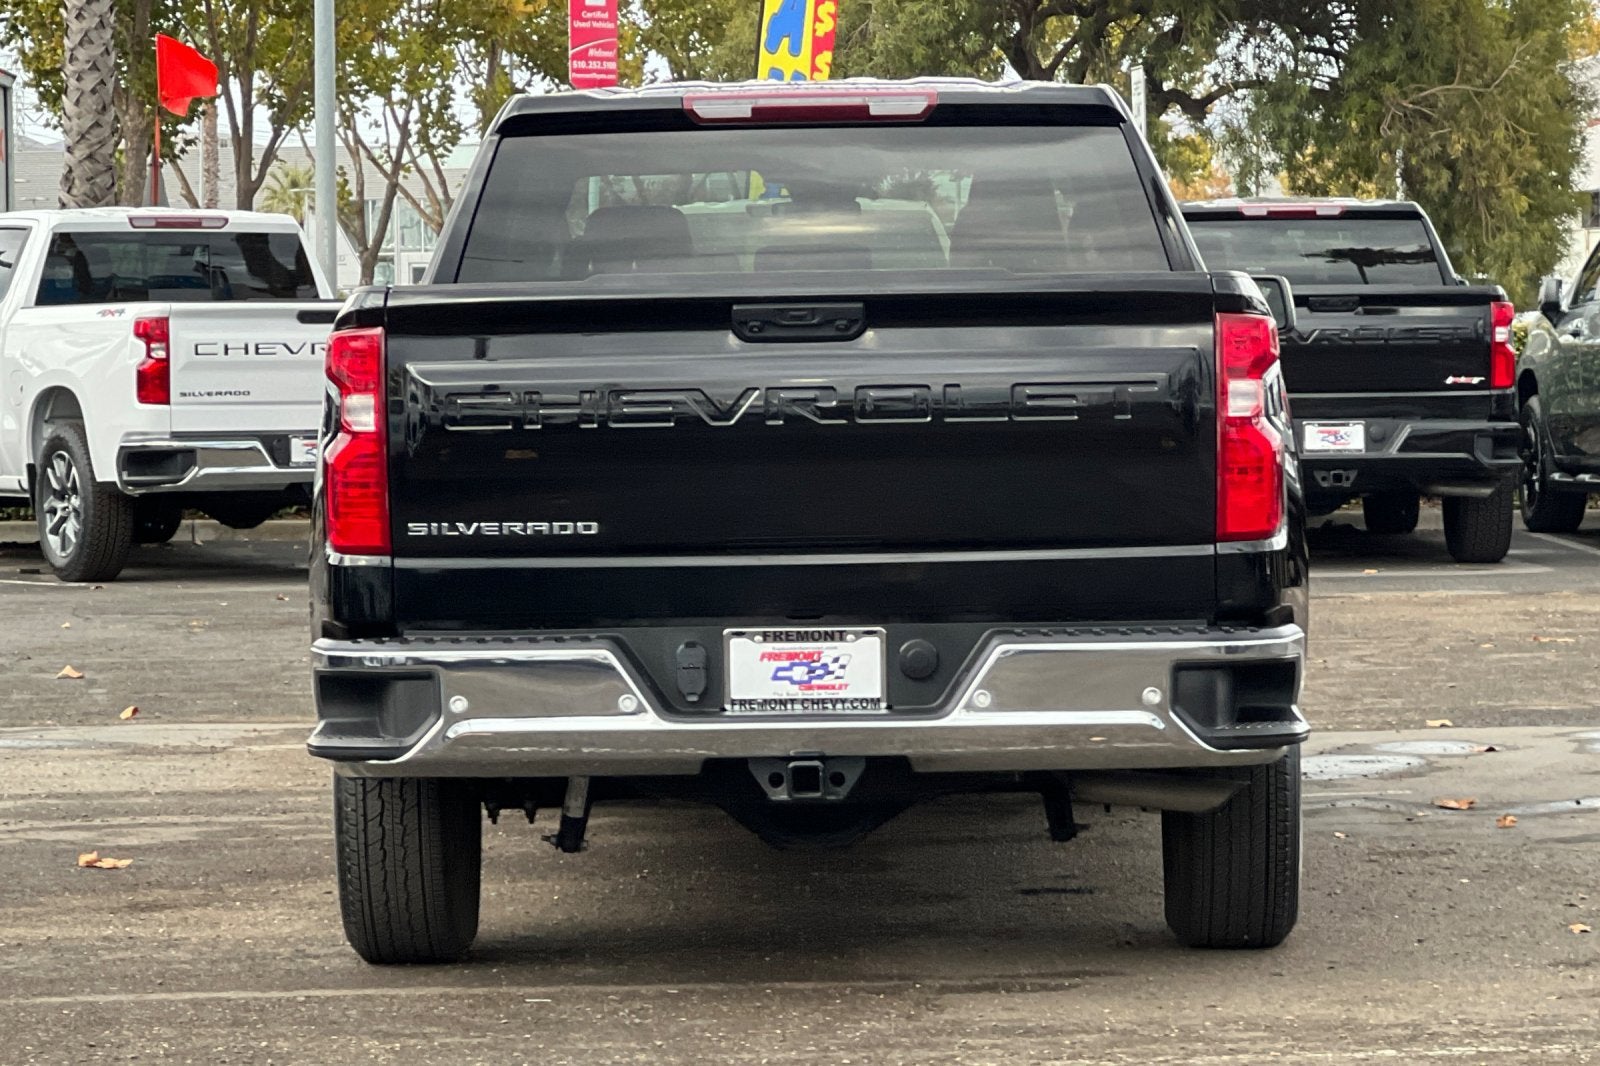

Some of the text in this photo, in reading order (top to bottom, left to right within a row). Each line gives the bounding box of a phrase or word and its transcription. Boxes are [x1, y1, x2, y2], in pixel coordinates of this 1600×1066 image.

[581, 10, 609, 19] Certified
[573, 20, 615, 29] Used Vehicles
[1280, 327, 1472, 344] VROLET
[444, 381, 1158, 431] CHEVROLET
[407, 521, 599, 537] SILVERADO
[763, 630, 846, 642] FREMONT
[759, 650, 824, 662] FREMONT
